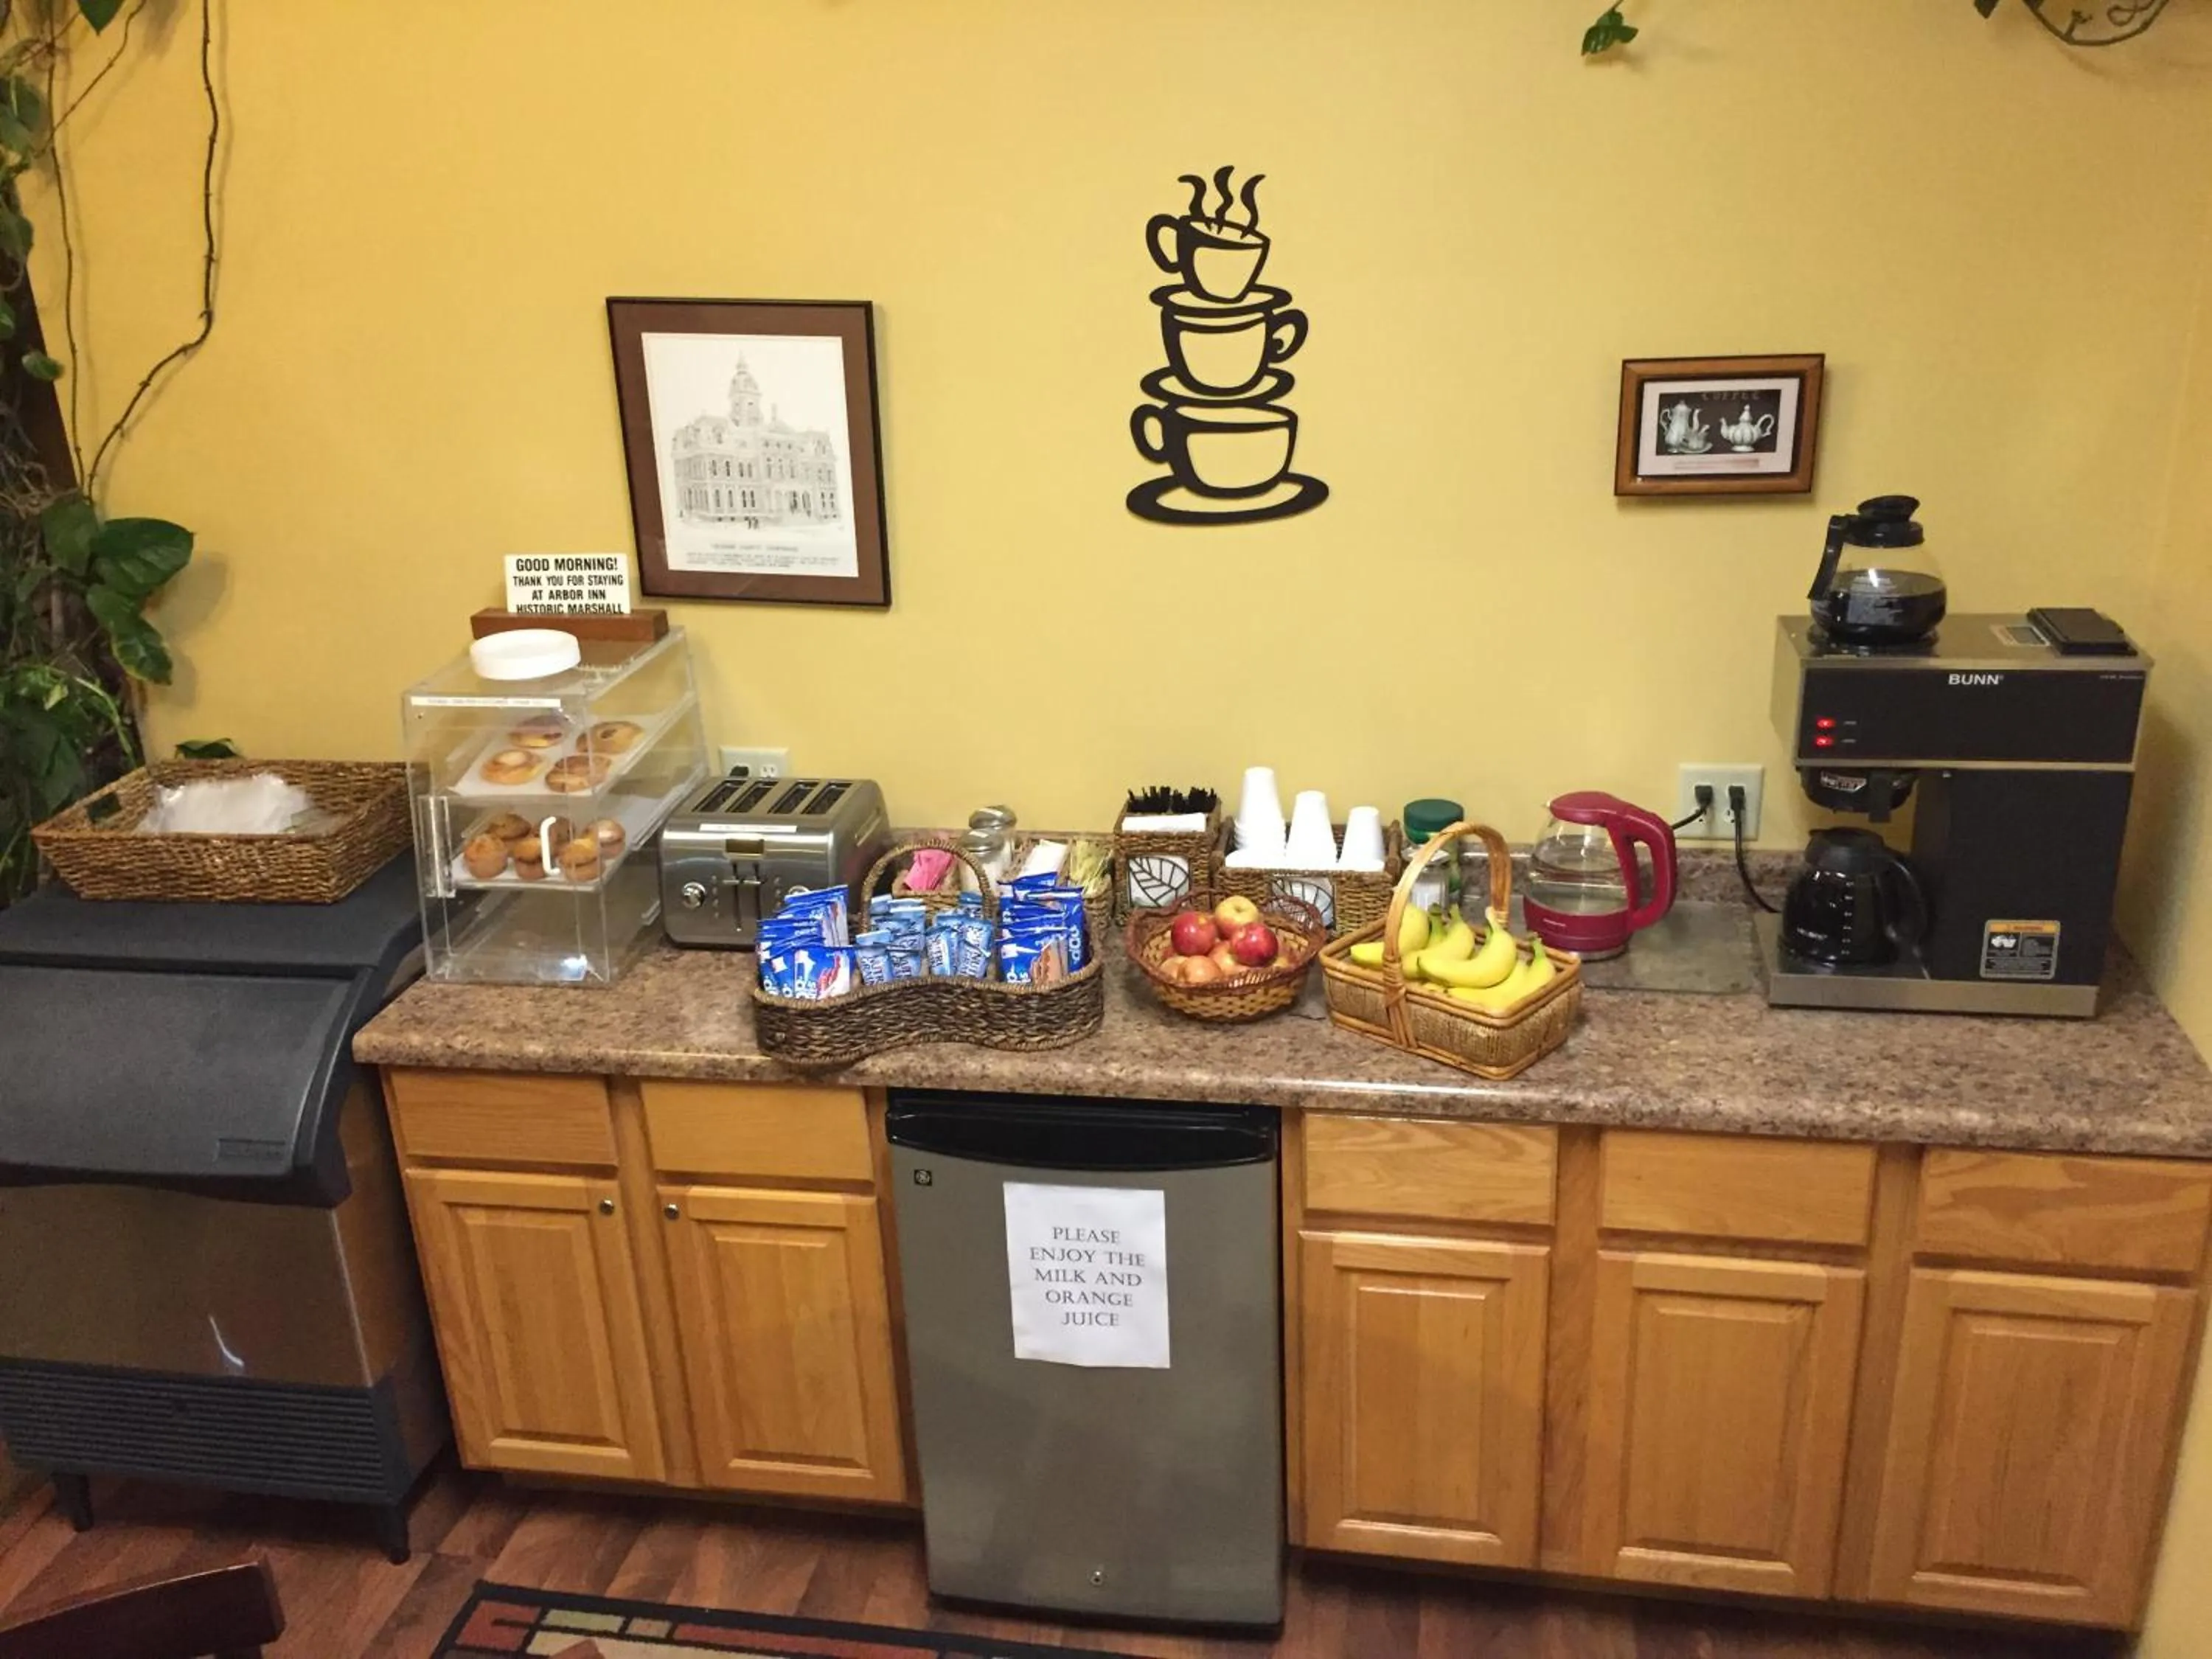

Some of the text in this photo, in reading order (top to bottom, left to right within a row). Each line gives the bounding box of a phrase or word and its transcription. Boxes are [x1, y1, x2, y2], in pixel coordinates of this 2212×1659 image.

[516, 557, 618, 571] GOOD MORNING!
[512, 574, 624, 586] THANK YOU FOR STAYING
[532, 590, 606, 601] AT ARBOR INN
[516, 603, 623, 614] HISTORIC MARSHALL
[1948, 673, 2000, 685] BUNN
[1052, 1227, 1120, 1244] PLEASE
[1030, 1247, 1145, 1266] ENJOY THE
[1034, 1267, 1142, 1287] MILK AND
[1045, 1290, 1133, 1307] ORANGE
[1061, 1312, 1120, 1326] JUICE
